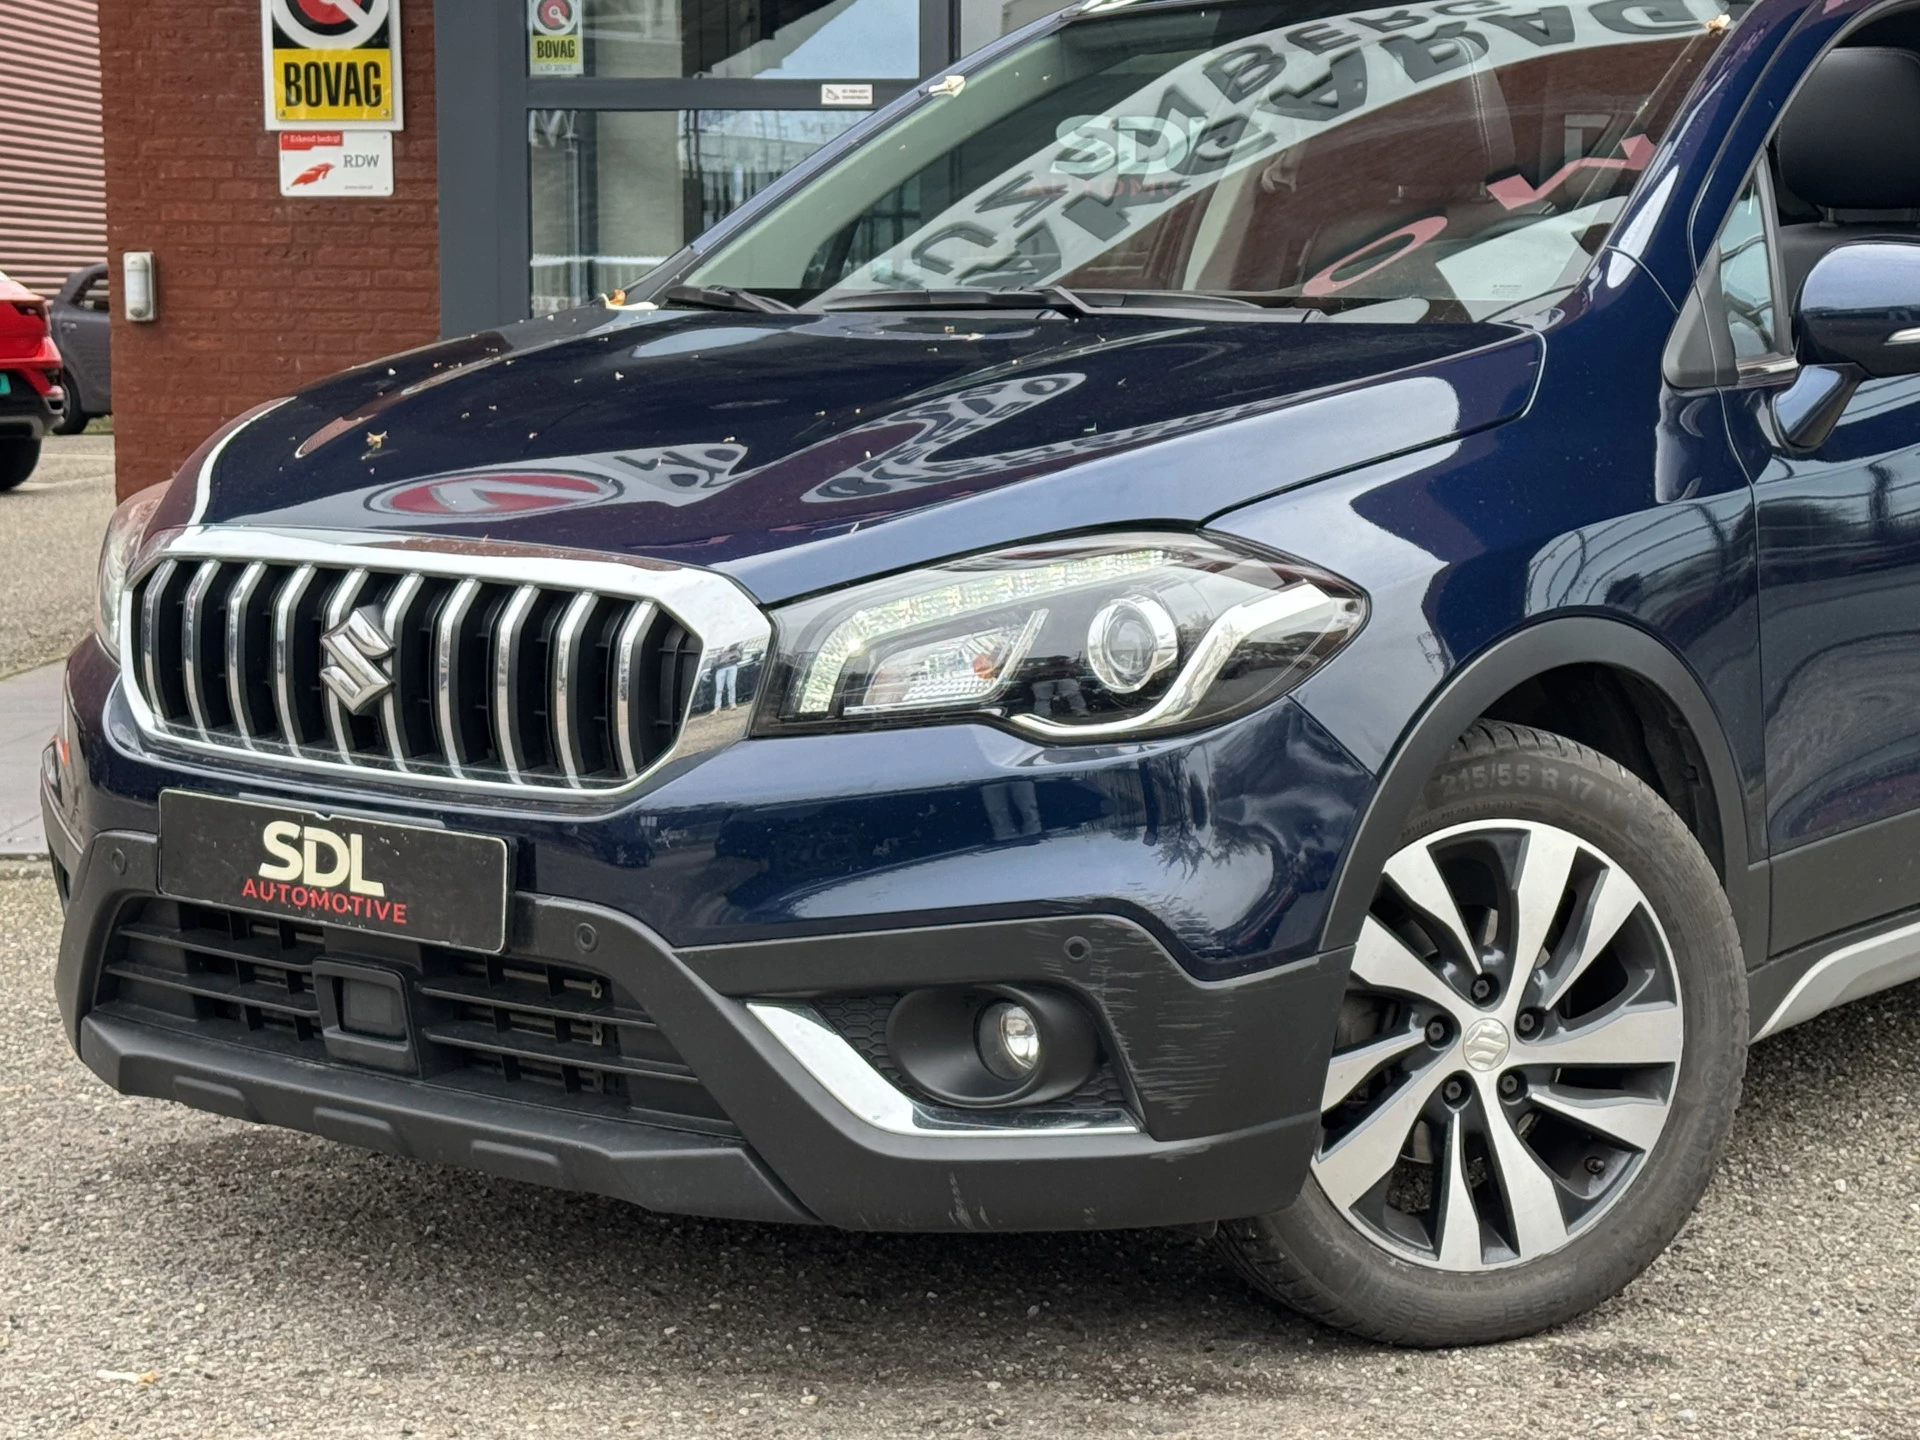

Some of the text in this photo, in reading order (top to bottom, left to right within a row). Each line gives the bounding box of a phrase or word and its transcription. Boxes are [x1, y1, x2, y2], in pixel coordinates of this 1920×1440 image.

[537, 39, 576, 59] BOVAG
[284, 61, 383, 107] BOVAG
[343, 154, 380, 168] RDW
[1440, 763, 1531, 797] 215/55
[1541, 767, 1560, 791] R
[1568, 774, 1596, 800] 17
[258, 820, 385, 897] SDL
[242, 878, 407, 924] AUTOMOTIVE
